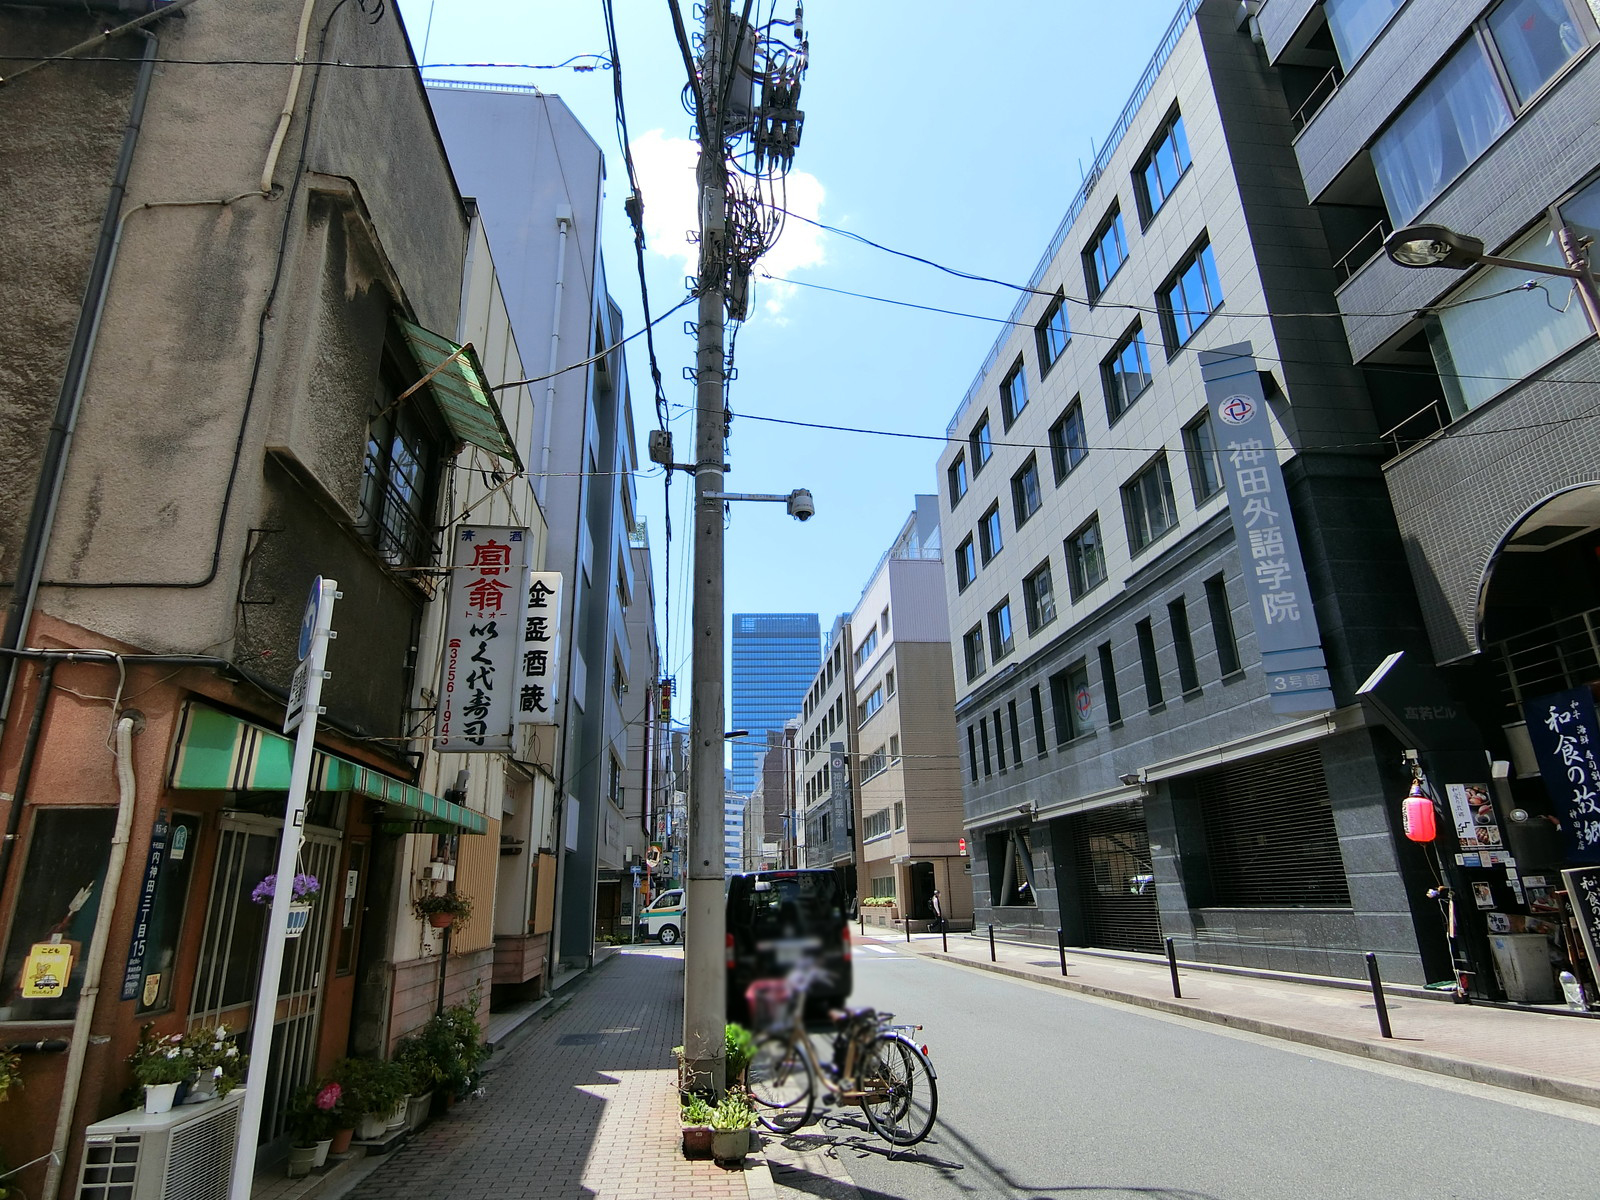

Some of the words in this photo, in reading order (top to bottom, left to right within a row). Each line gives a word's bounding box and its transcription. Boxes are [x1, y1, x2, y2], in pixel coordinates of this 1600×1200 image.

[1228, 438, 1300, 625] 神田外語学院
[465, 611, 508, 619] トミオー
[520, 580, 555, 713] 金盃酒蔵
[1274, 673, 1321, 690] 3号館
[833, 772, 844, 828] 神田外語学院
[133, 940, 146, 957] 15
